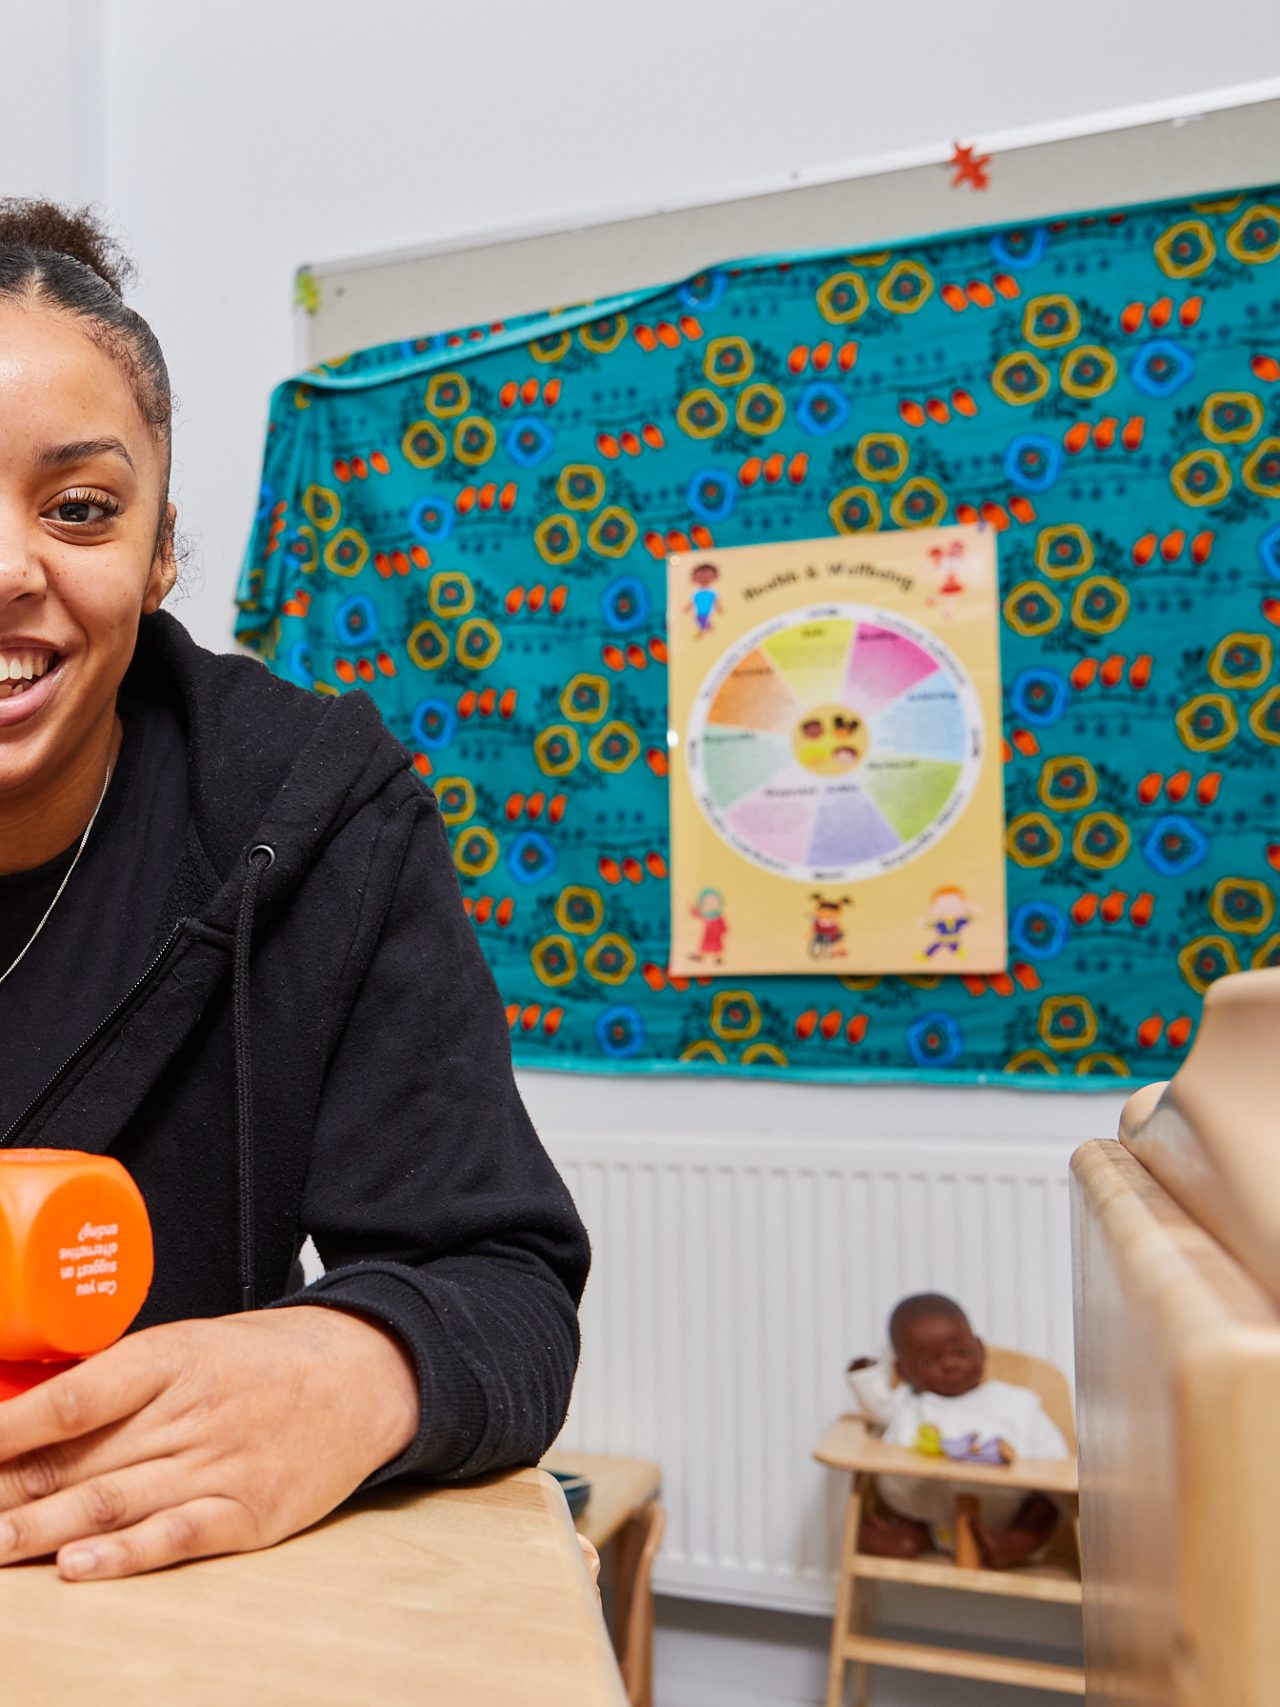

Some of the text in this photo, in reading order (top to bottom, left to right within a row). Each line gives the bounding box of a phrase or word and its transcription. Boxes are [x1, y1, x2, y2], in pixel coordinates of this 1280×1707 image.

[77, 1222, 119, 1242] ending?
[59, 1242, 118, 1261] alternative
[60, 1258, 118, 1279] suggest an
[76, 1279, 117, 1296] Can you
